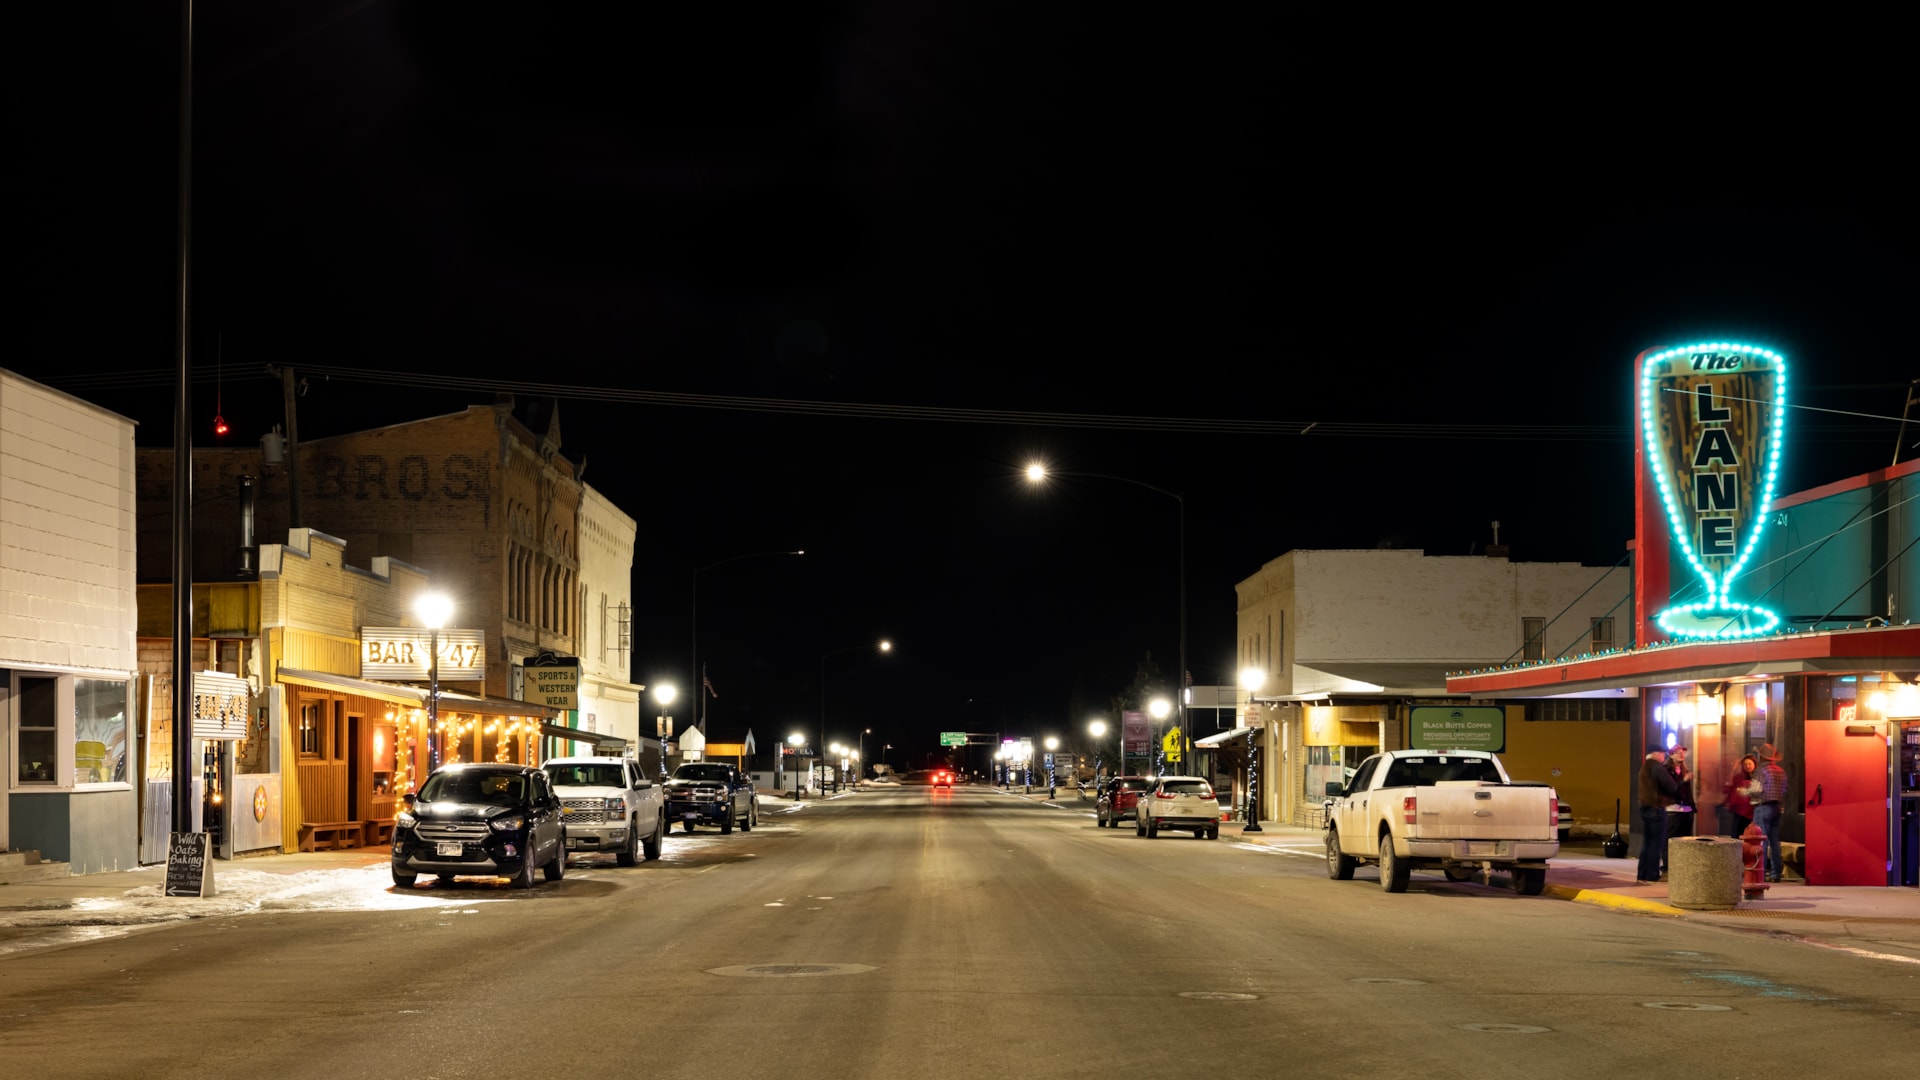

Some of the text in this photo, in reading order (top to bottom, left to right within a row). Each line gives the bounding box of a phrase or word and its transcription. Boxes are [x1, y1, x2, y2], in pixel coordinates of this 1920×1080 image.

[1691, 352, 1740, 370] The
[1692, 383, 1740, 556] LANE
[369, 641, 480, 668] BAR 47
[538, 671, 568, 680] SPORTS
[570, 672, 575, 680] &
[538, 684, 576, 693] WESTERN
[546, 696, 568, 705] WEAR
[178, 833, 198, 844] Wild
[175, 845, 197, 855] Oats
[170, 854, 202, 867] Baking
